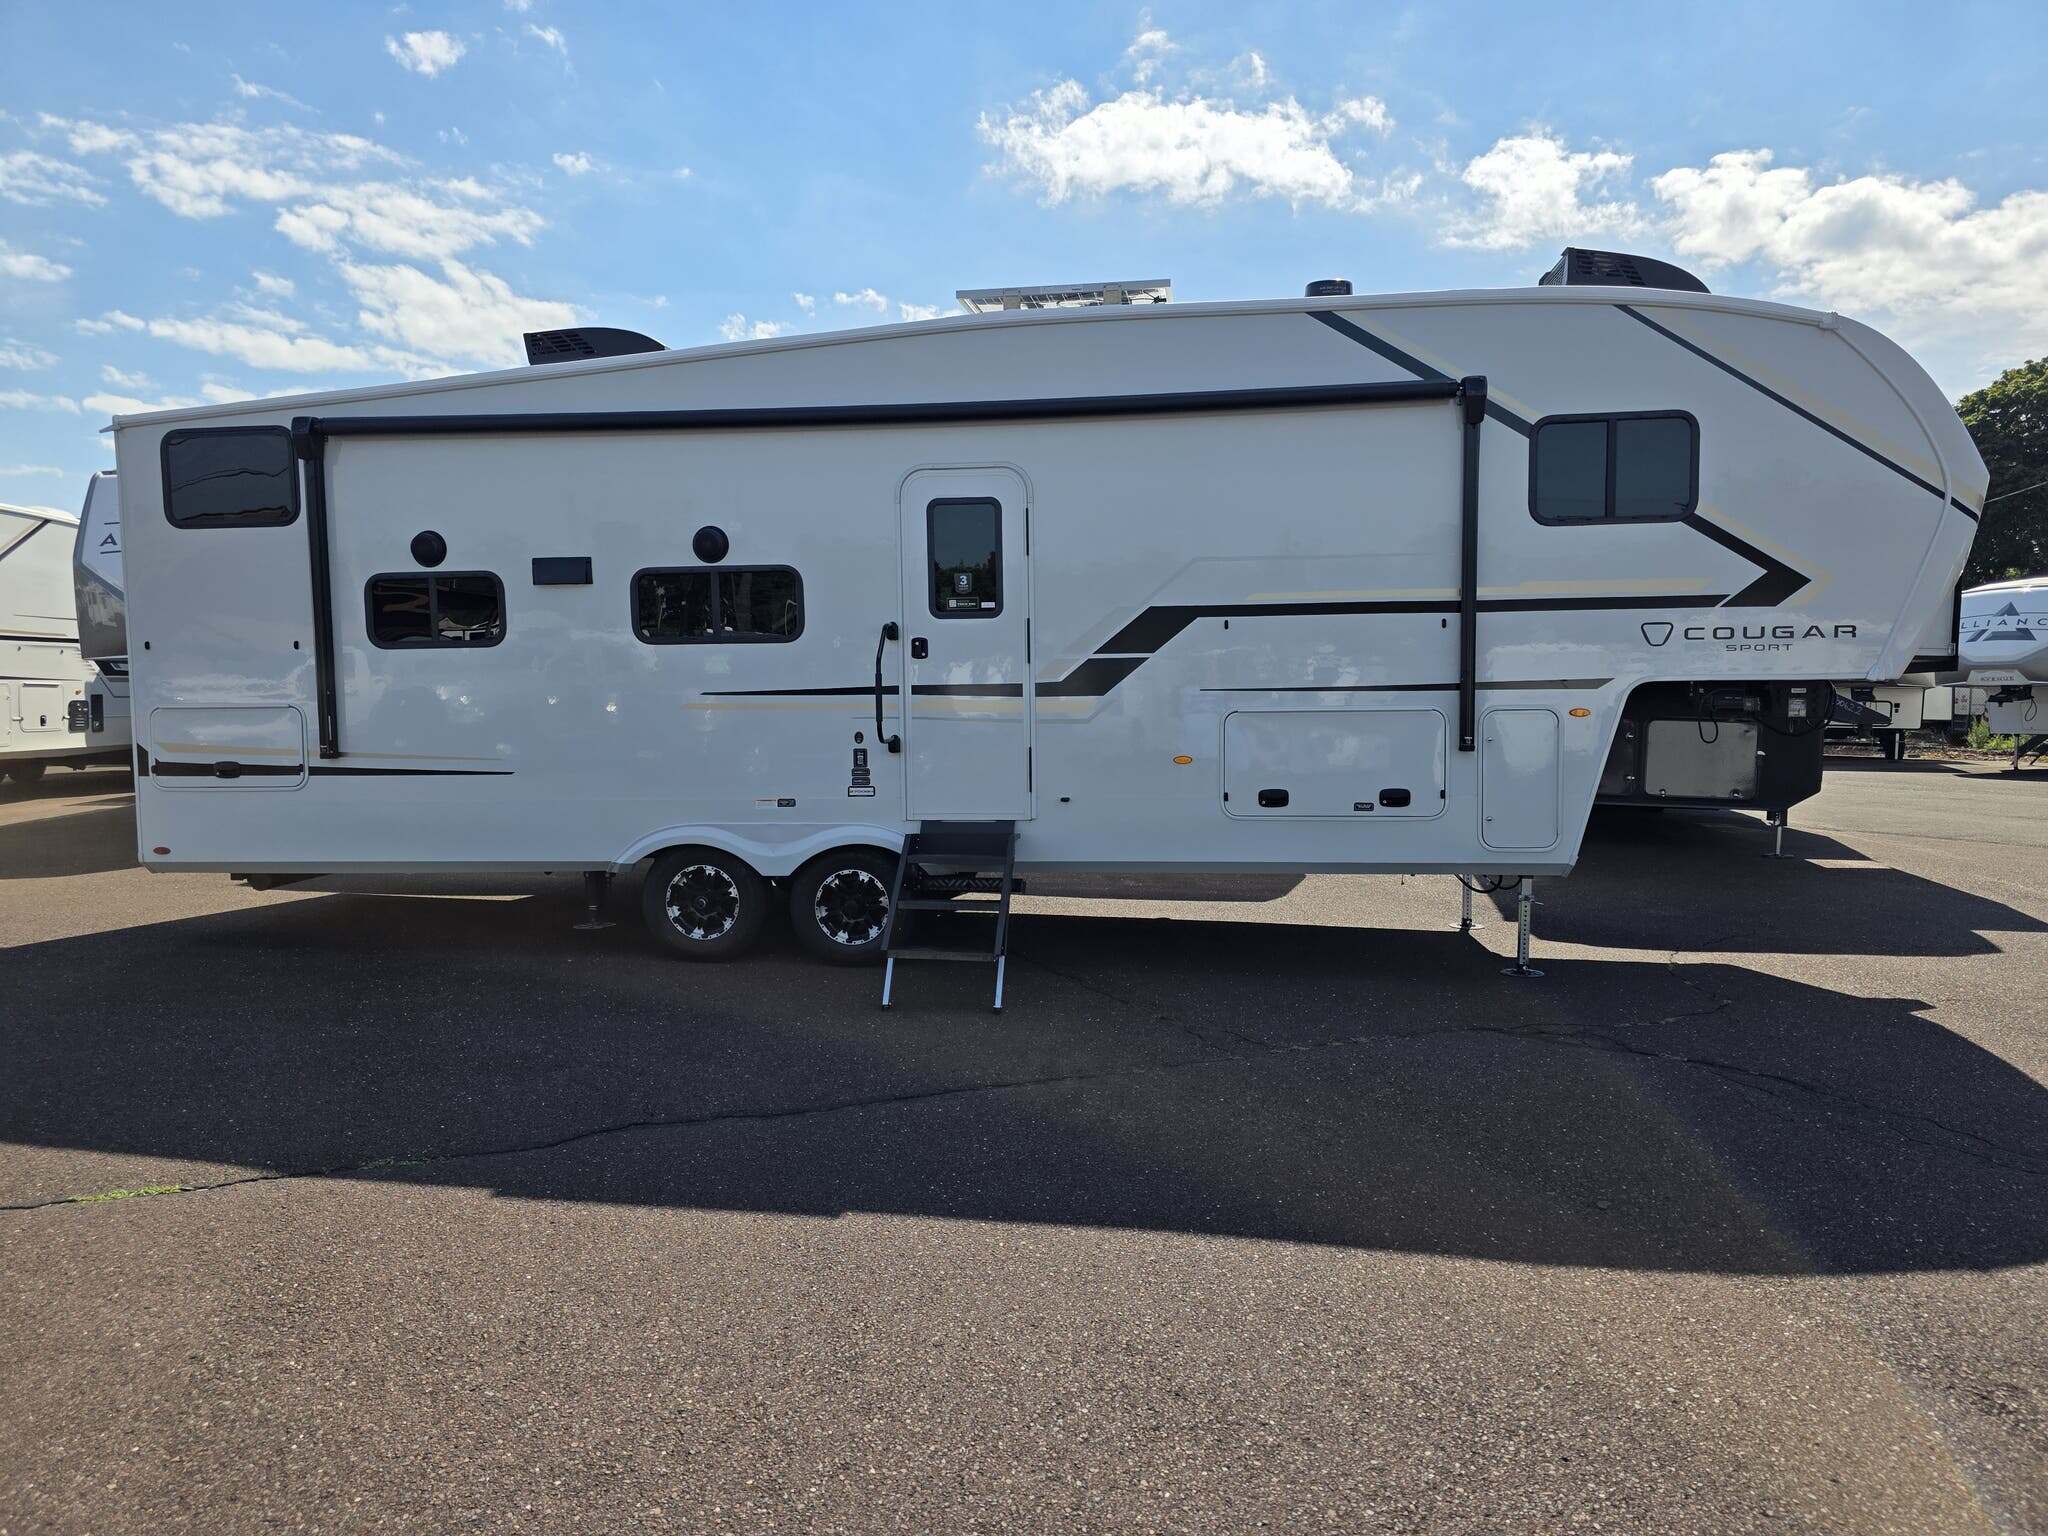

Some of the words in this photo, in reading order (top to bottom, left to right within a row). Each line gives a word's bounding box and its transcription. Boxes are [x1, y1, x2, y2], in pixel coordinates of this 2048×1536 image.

[959, 575, 968, 585] 3
[1960, 617, 2048, 630] LLIANC
[1683, 624, 1858, 641] COUGAR
[1725, 643, 1793, 652] SPORT
